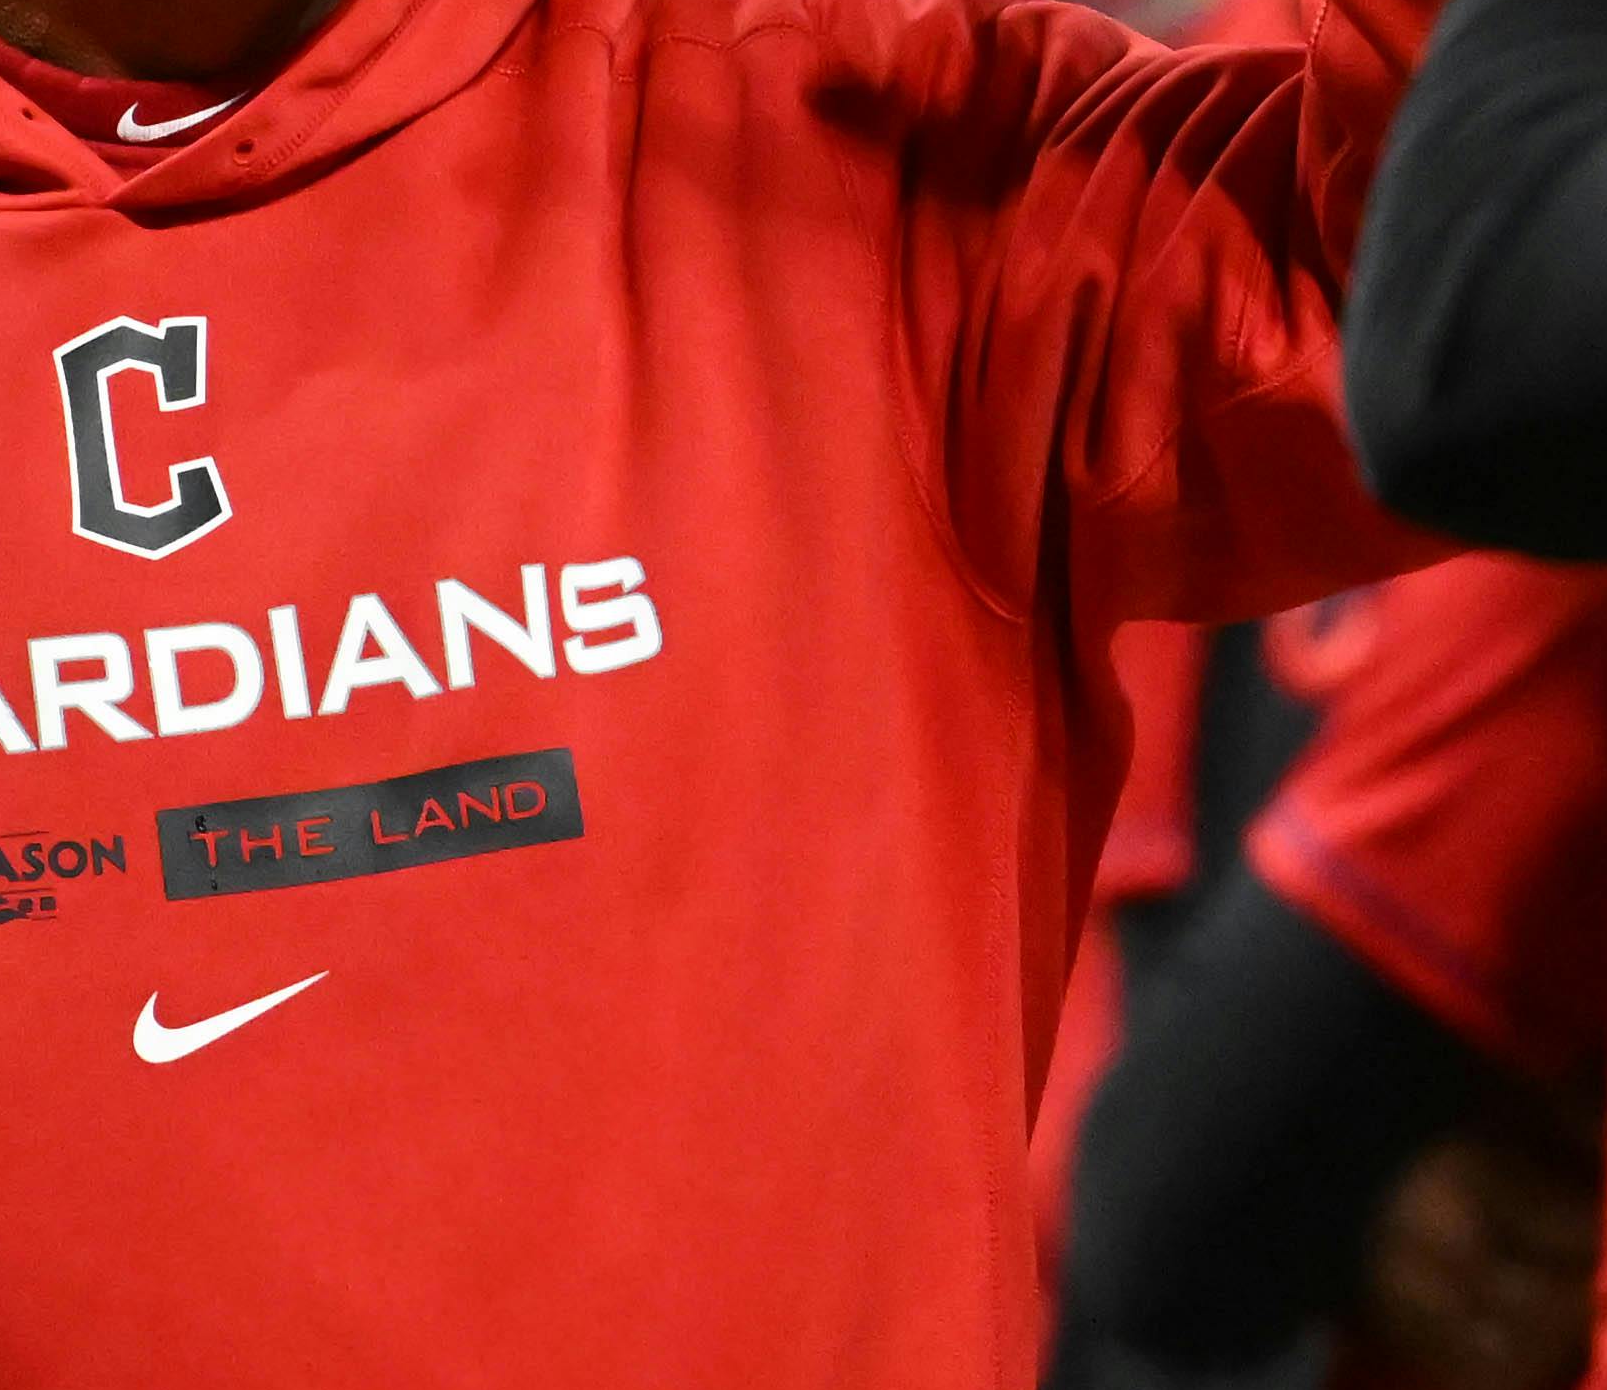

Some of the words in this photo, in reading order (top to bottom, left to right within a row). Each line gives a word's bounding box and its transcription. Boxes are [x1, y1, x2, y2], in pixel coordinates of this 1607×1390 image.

[53, 316, 232, 561] C
[189, 816, 335, 867] THE
[369, 780, 547, 846] LAND
